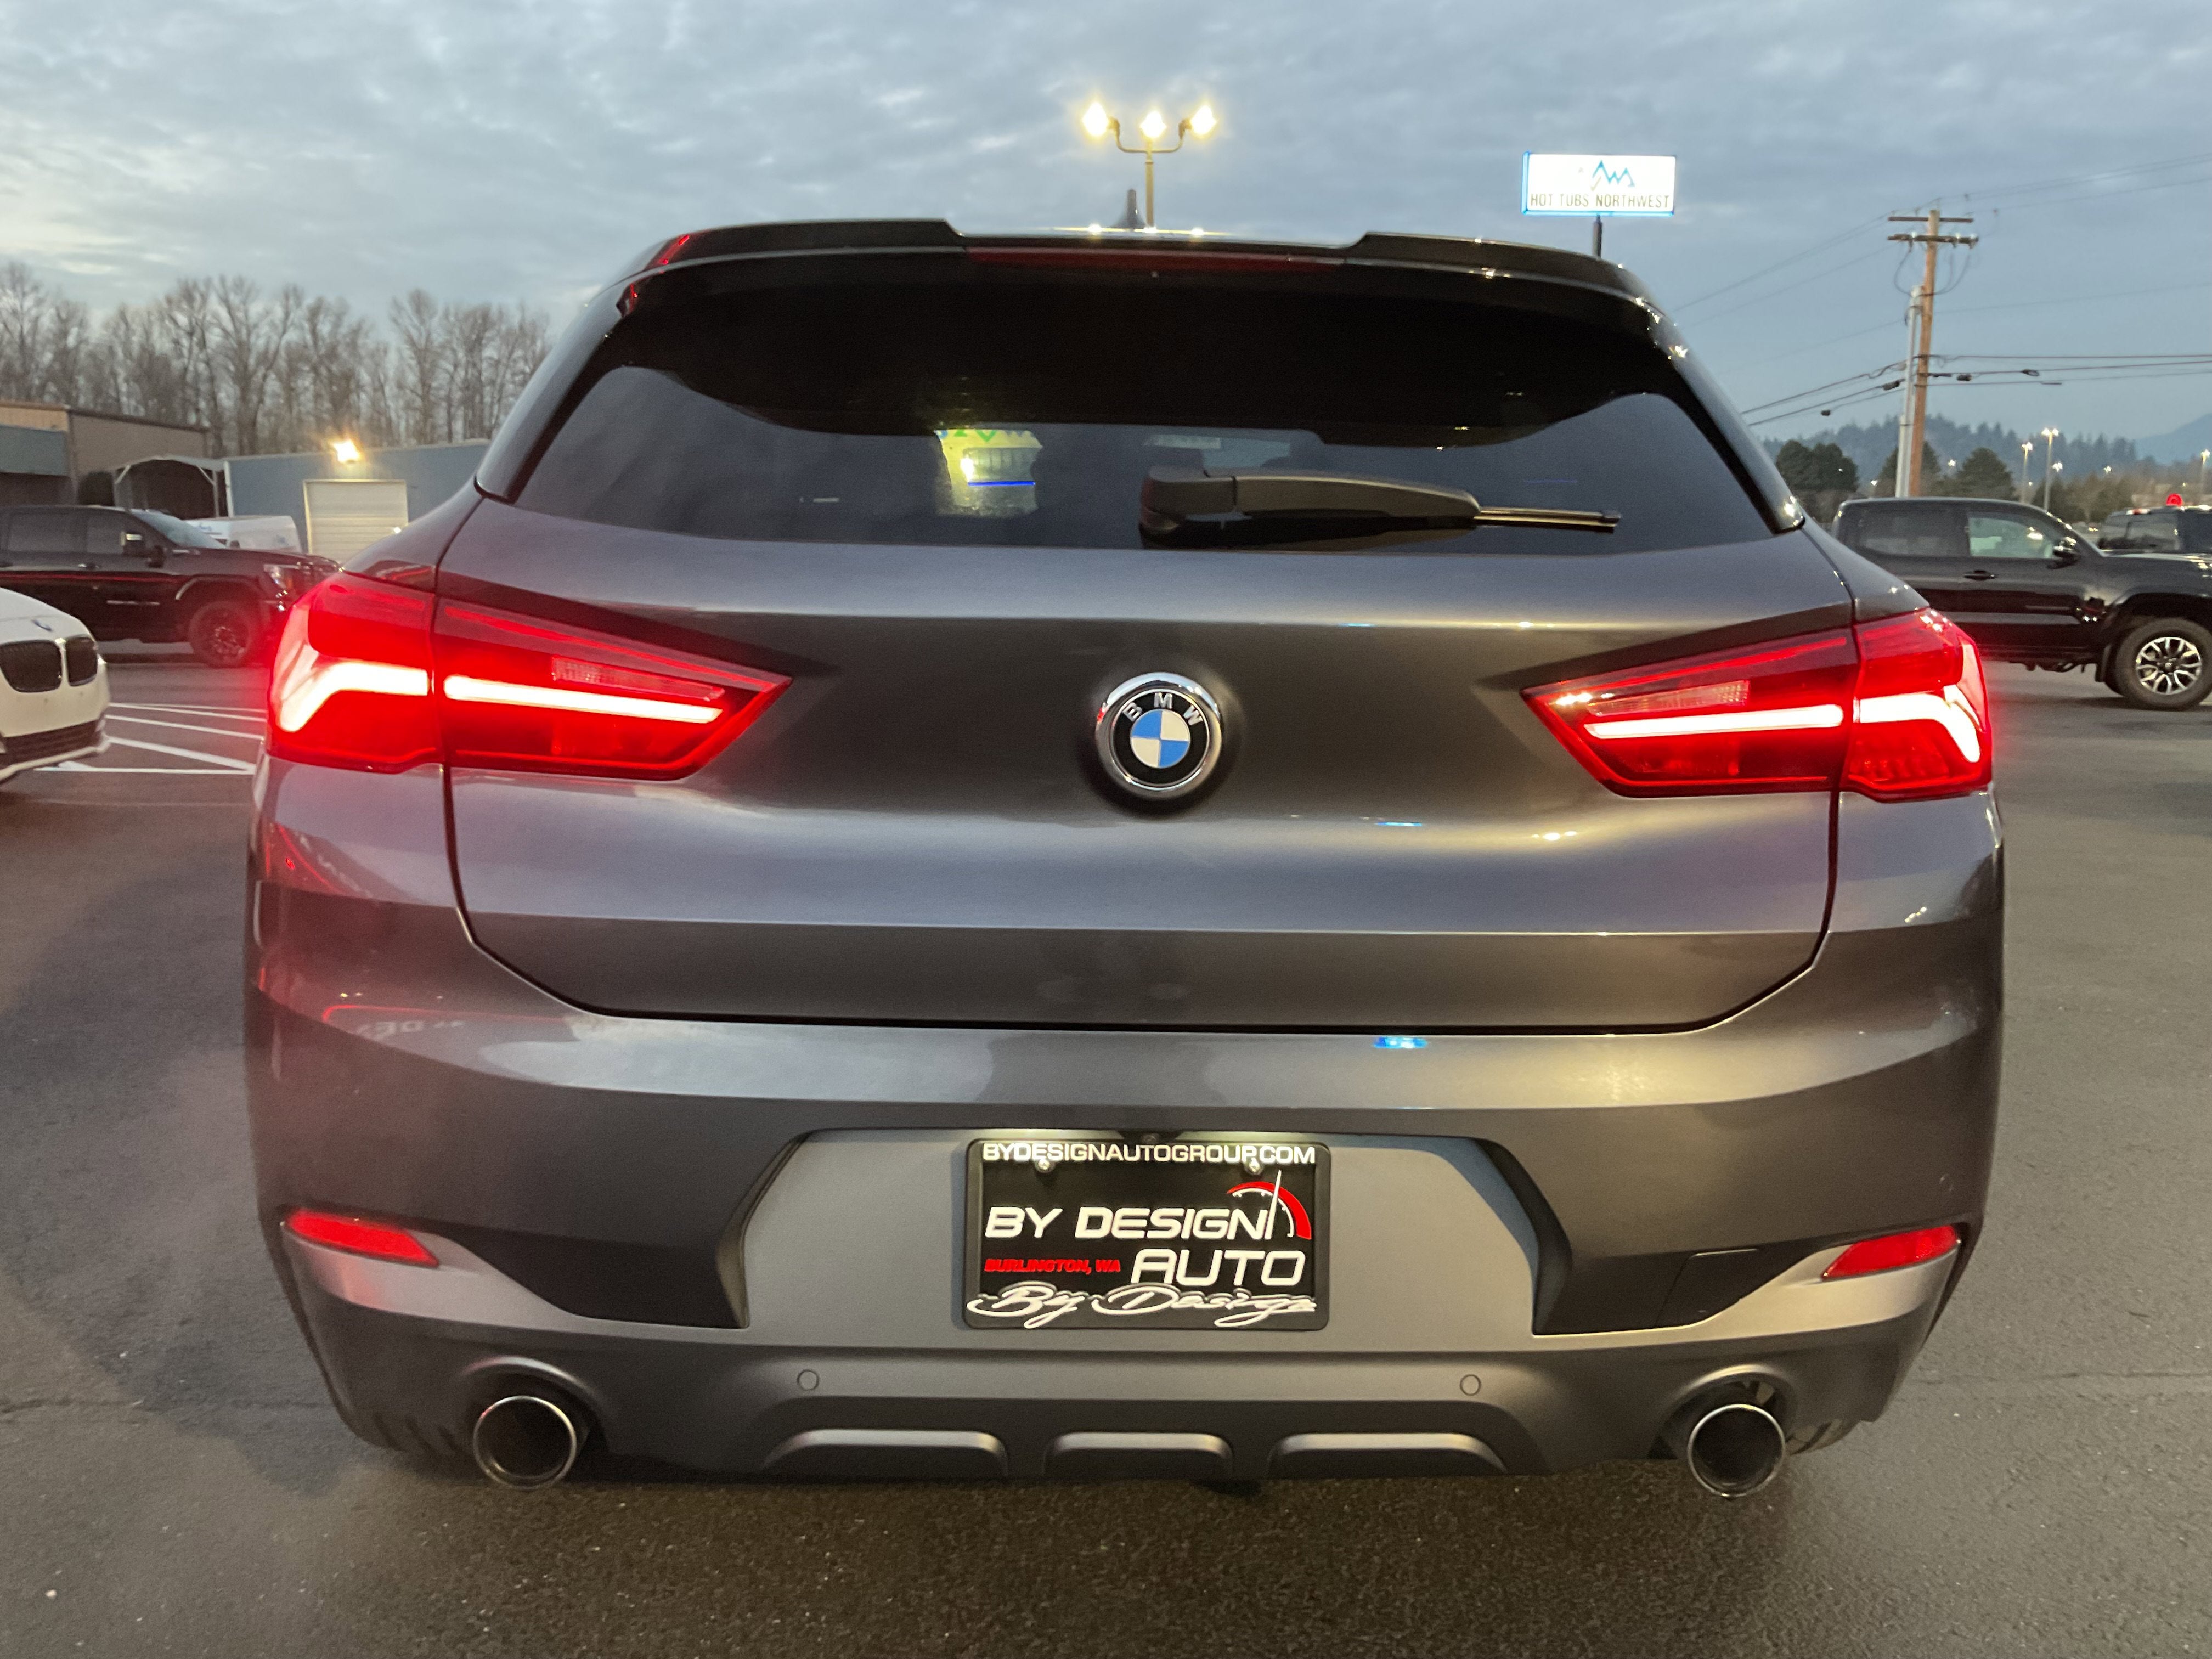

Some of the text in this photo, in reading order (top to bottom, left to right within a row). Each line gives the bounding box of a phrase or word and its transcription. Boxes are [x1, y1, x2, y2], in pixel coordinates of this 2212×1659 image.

[1530, 194, 1669, 208] HOT TUBS NORTHWEST
[1122, 692, 1203, 725] BMW
[983, 1143, 1316, 1164] BYDESIGNAUTOGROUP.COM
[985, 1207, 1268, 1240] BY DESIGN
[984, 1259, 1121, 1275] BURLINGTON, WA
[1130, 1248, 1306, 1286] AUTO
[966, 1285, 1317, 1329] By Design
